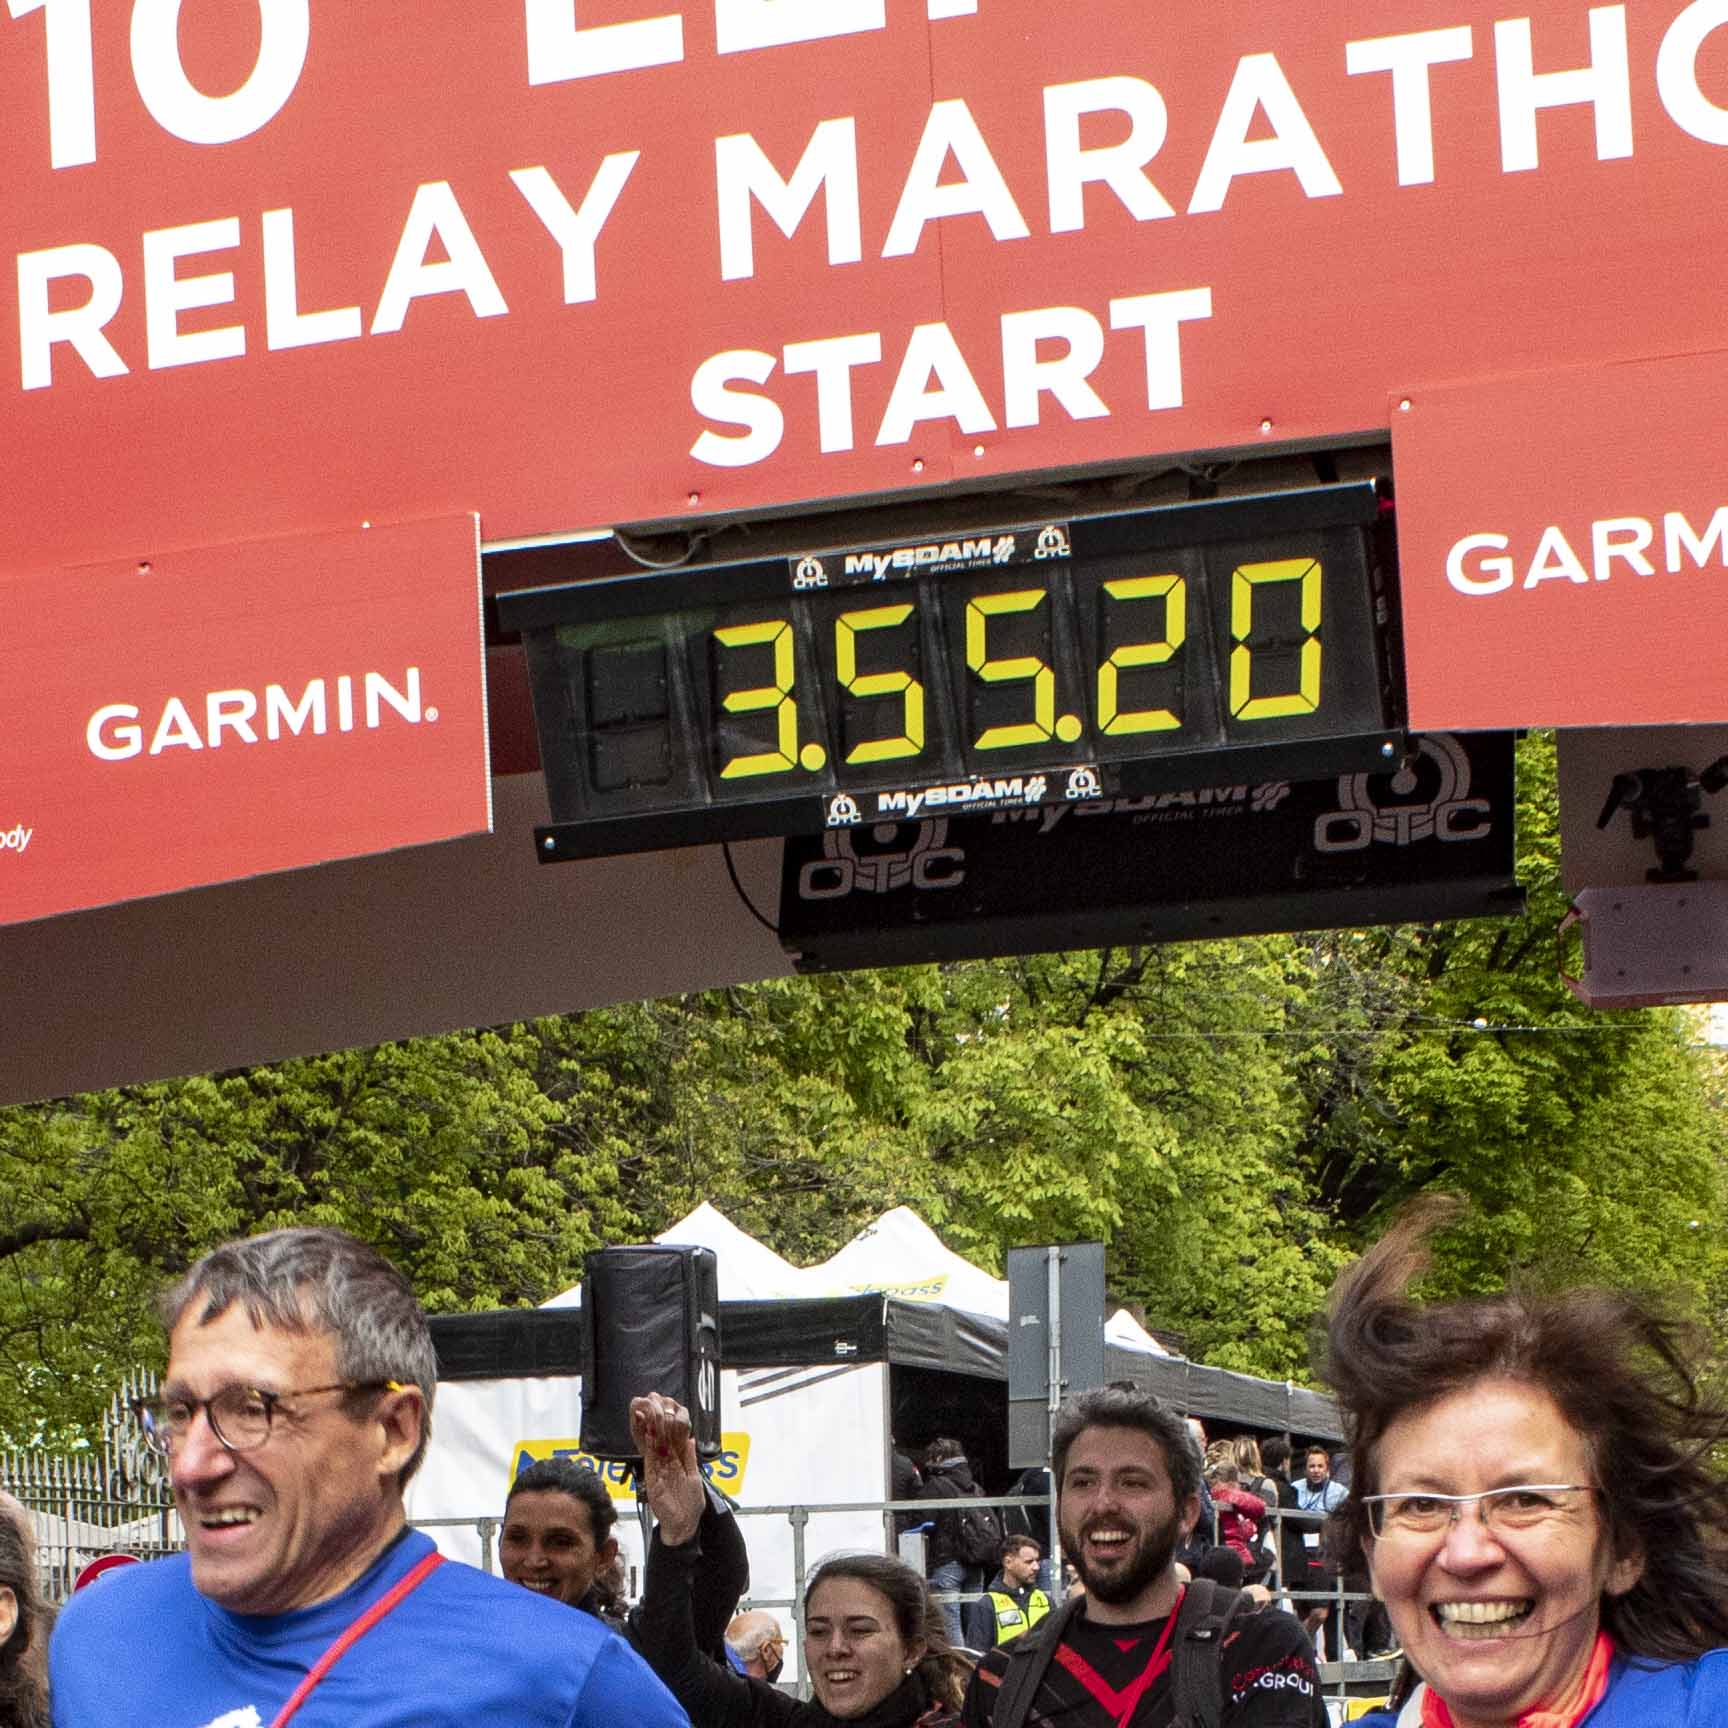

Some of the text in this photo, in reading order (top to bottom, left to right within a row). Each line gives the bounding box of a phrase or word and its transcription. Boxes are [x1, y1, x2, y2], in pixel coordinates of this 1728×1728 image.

[16, 150, 641, 391] RELAY
[690, 287, 1213, 467] START
[844, 540, 993, 581] MySDAM
[877, 777, 1024, 817] MySDAM
[1313, 799, 1492, 853] OTC
[798, 848, 966, 900] OTC
